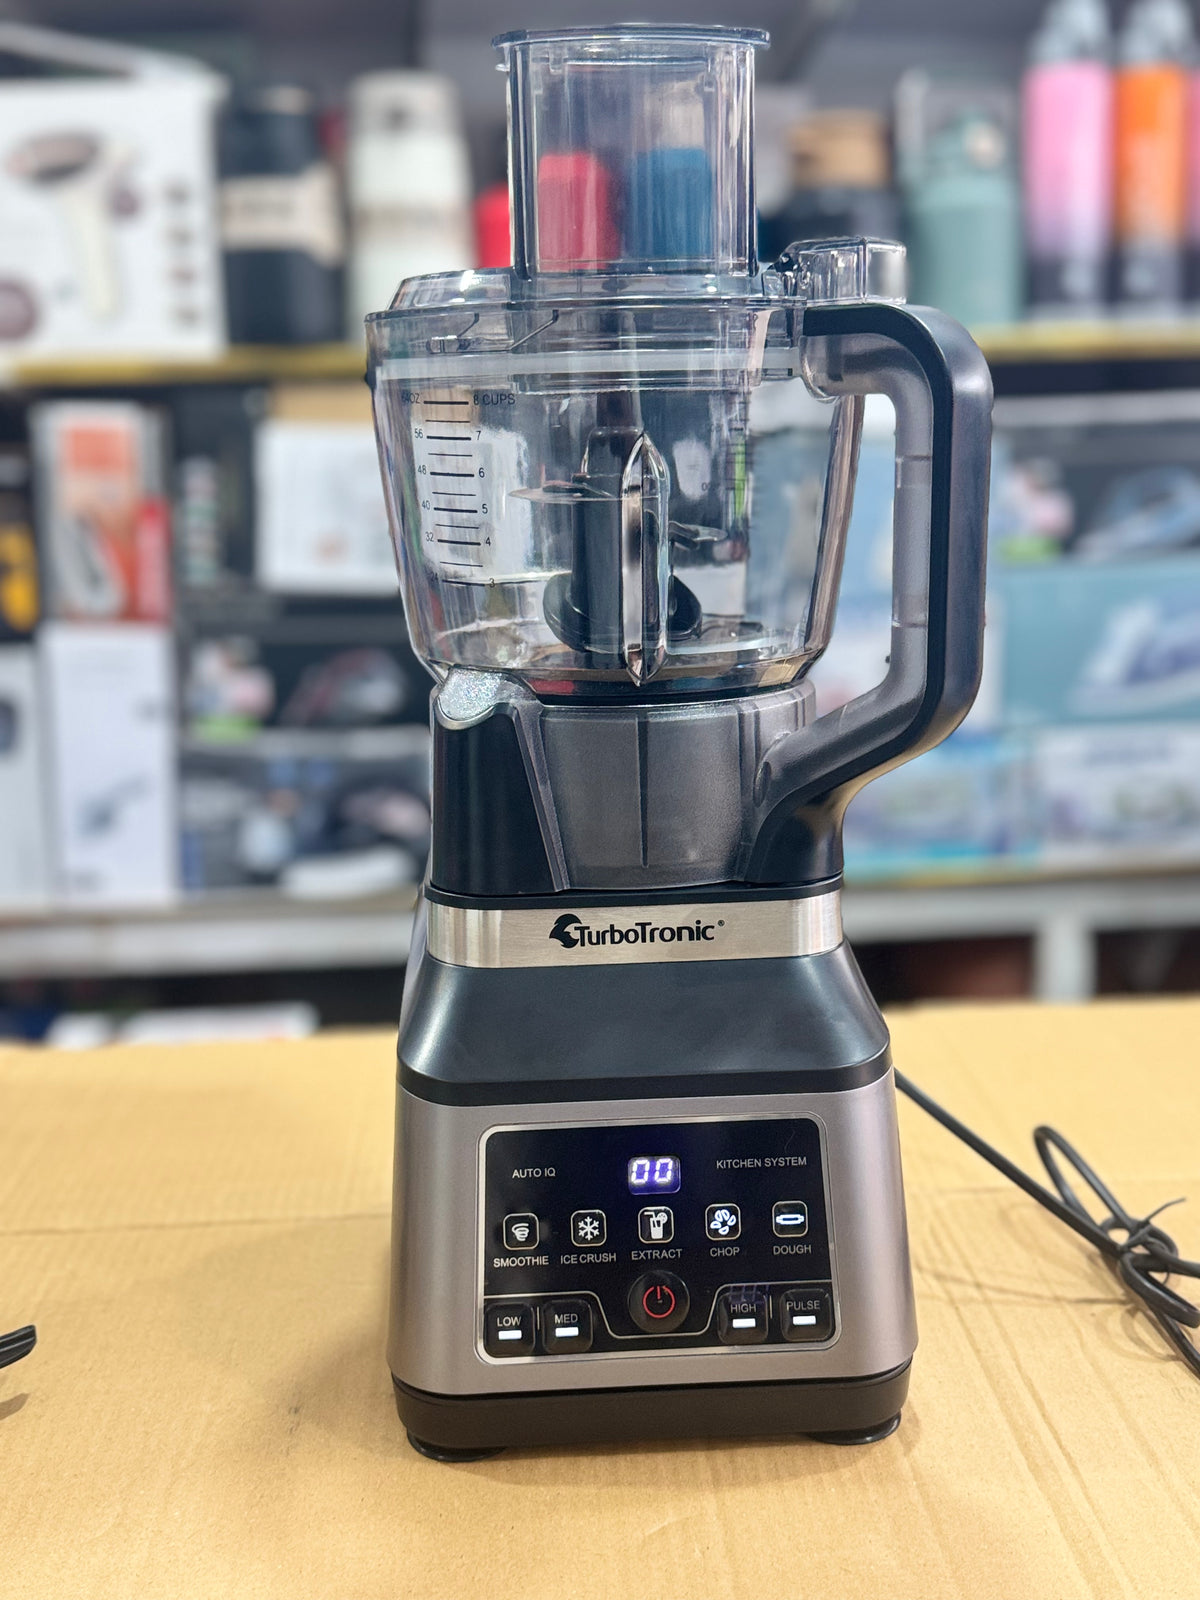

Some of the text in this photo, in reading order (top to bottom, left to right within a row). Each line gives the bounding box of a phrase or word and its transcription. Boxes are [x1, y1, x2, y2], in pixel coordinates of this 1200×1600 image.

[482, 393, 516, 406] CUPS
[414, 428, 424, 439] 56
[475, 430, 482, 441] 7
[418, 464, 427, 475] 48
[478, 467, 485, 478] 6
[421, 500, 431, 511] 40
[482, 503, 488, 514] 5
[425, 532, 434, 542] 32
[485, 536, 491, 547] 4
[489, 577, 496, 588] 3
[716, 1156, 808, 1169] KITCHEN SYSTEM
[512, 1167, 556, 1179] AUTO IQ
[630, 1157, 674, 1184] 00
[631, 1248, 683, 1261] EXTRACT
[709, 1245, 740, 1257] CHOP
[772, 1244, 812, 1255] DOUGH
[493, 1255, 550, 1268] SMOOTHIE
[560, 1252, 617, 1265] ICE CRUSH
[730, 1303, 757, 1313] HIGH
[786, 1300, 821, 1311] PULSE
[497, 1315, 521, 1327] LOW
[554, 1312, 579, 1324] MED
